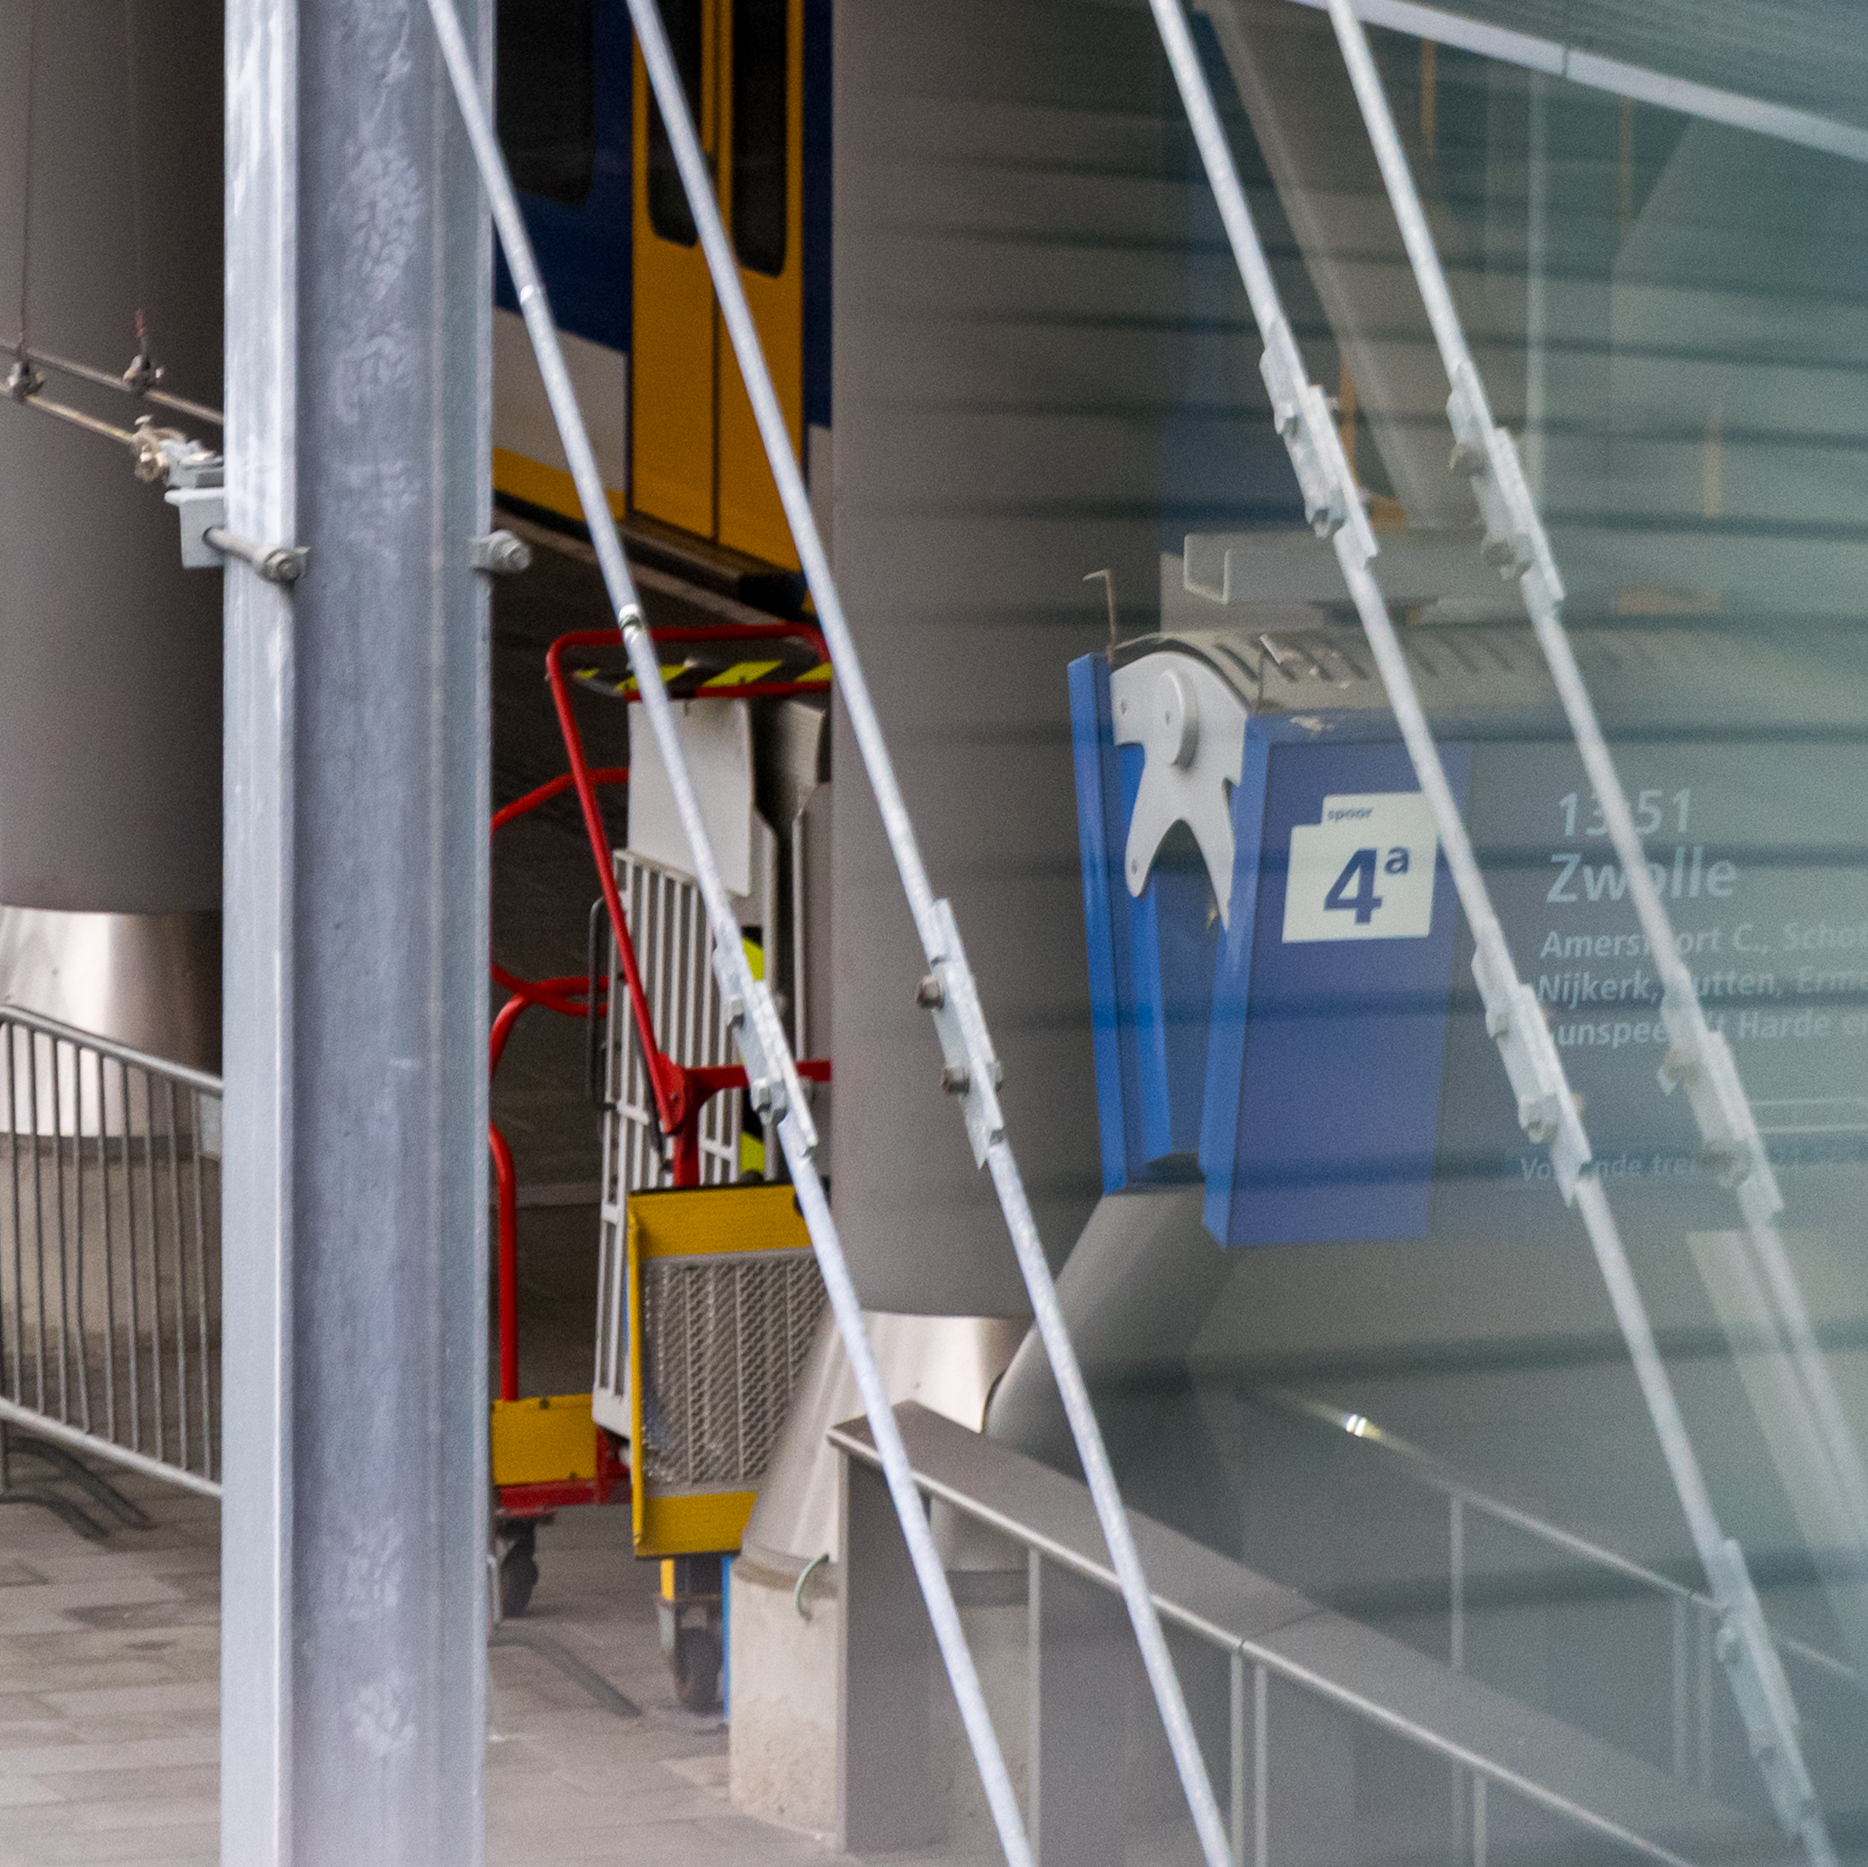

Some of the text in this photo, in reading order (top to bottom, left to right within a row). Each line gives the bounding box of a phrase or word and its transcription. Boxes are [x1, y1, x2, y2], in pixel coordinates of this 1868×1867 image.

[1327, 808, 1373, 822] spoor
[1558, 788, 1691, 836] 1351
[1539, 926, 1722, 960] Amersort
[1538, 969, 1659, 1008] Nijkerk,
[1689, 971, 1783, 999] utten,
[1738, 1009, 1831, 1041] Harde
[1519, 1151, 1641, 1182] Vonde
